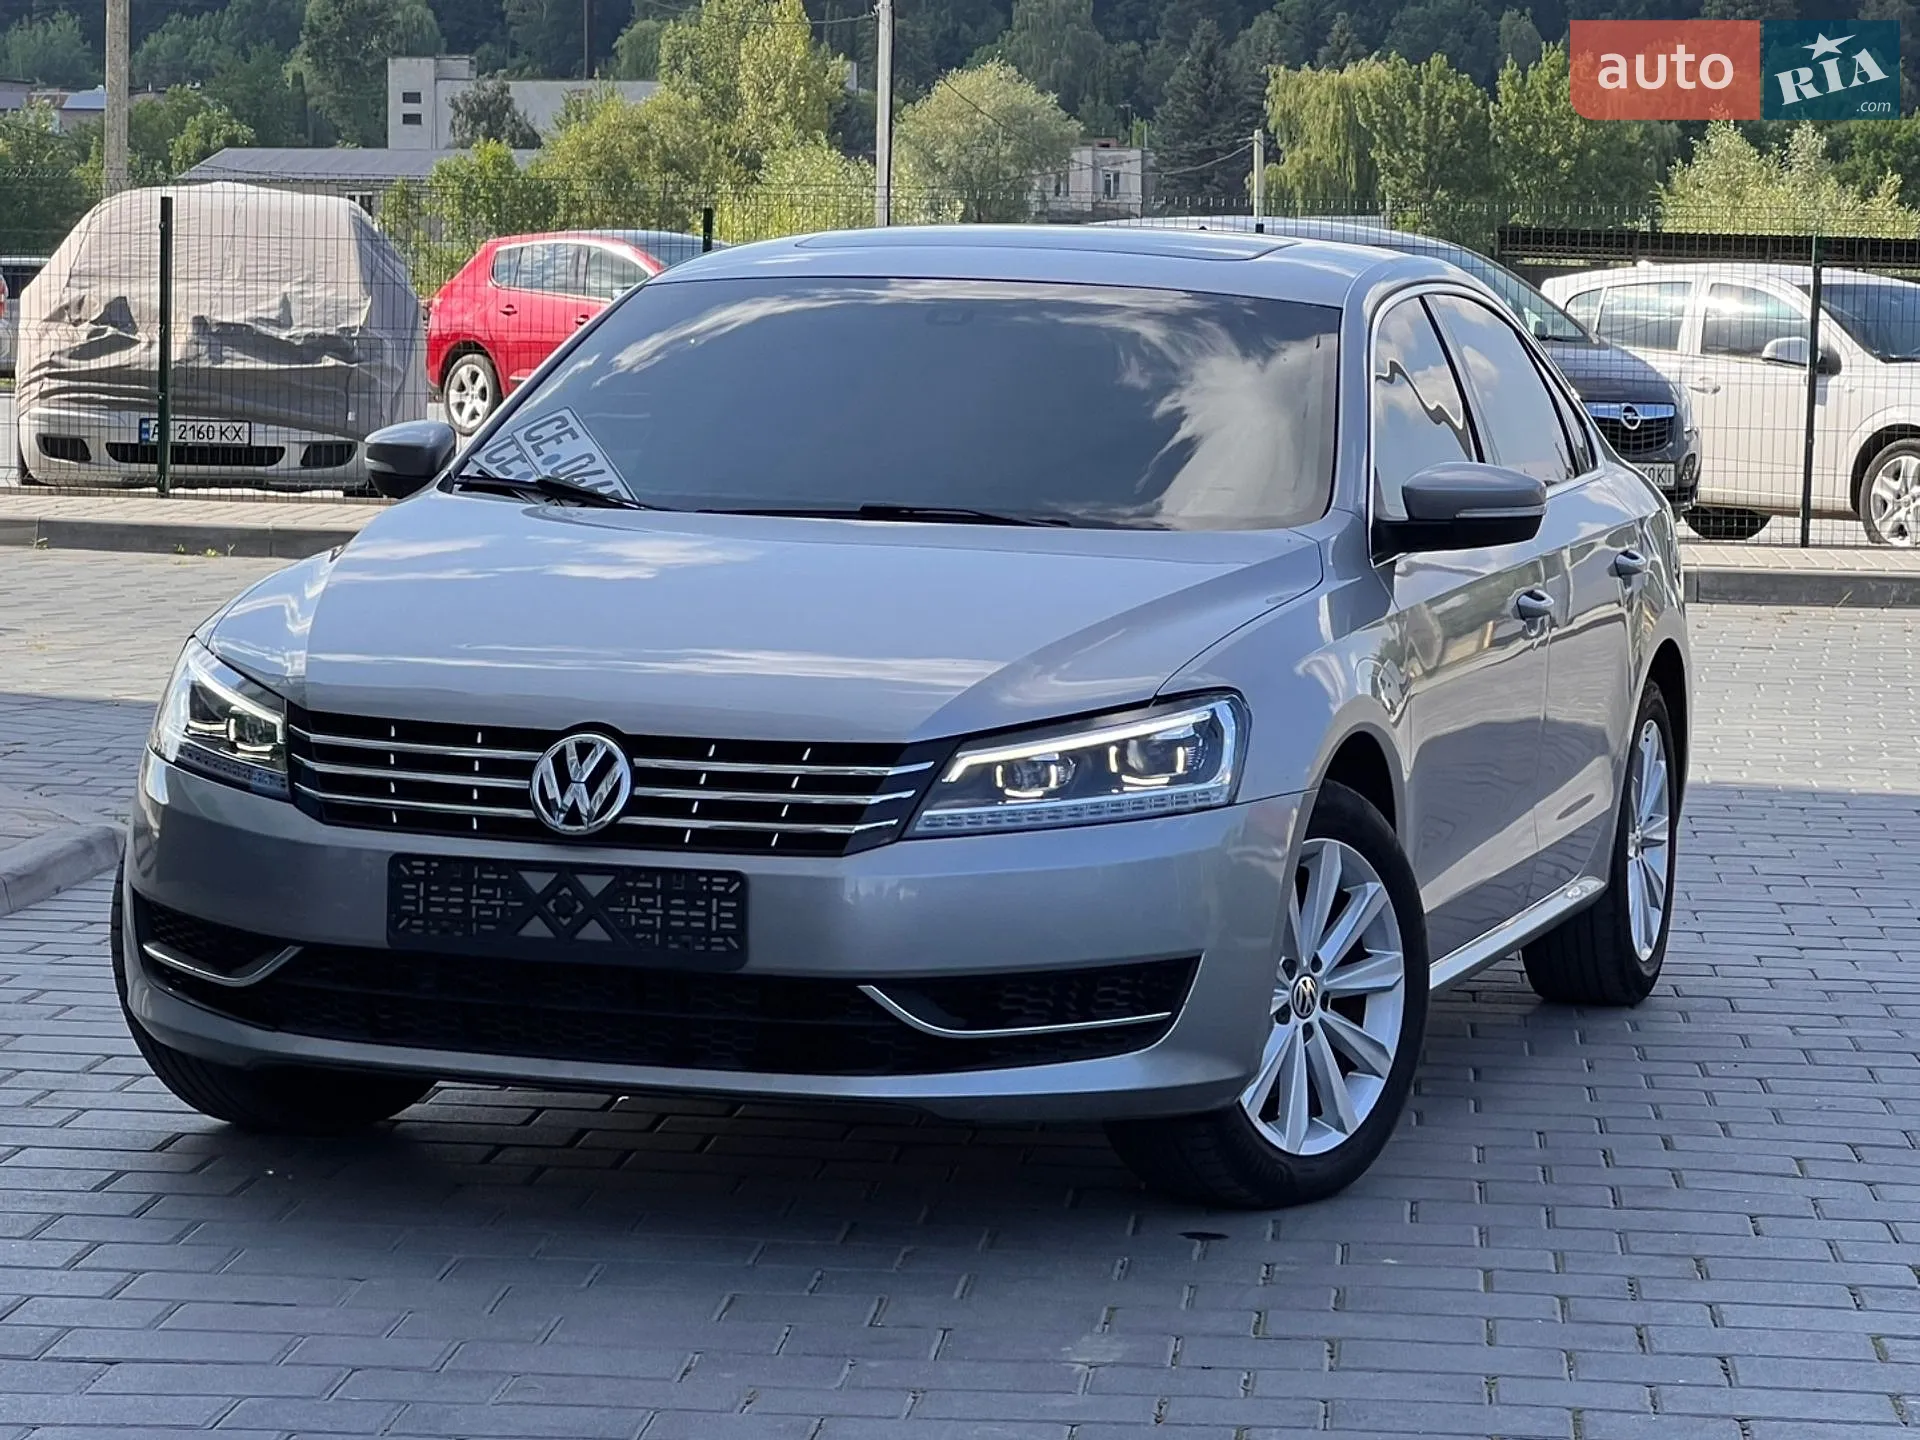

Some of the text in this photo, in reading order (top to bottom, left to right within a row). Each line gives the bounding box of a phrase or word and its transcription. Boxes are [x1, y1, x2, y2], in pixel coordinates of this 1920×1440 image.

[178, 424, 215, 440] 2160
[220, 425, 243, 441] KX
[523, 415, 579, 457] CE
[534, 735, 630, 833] VW
